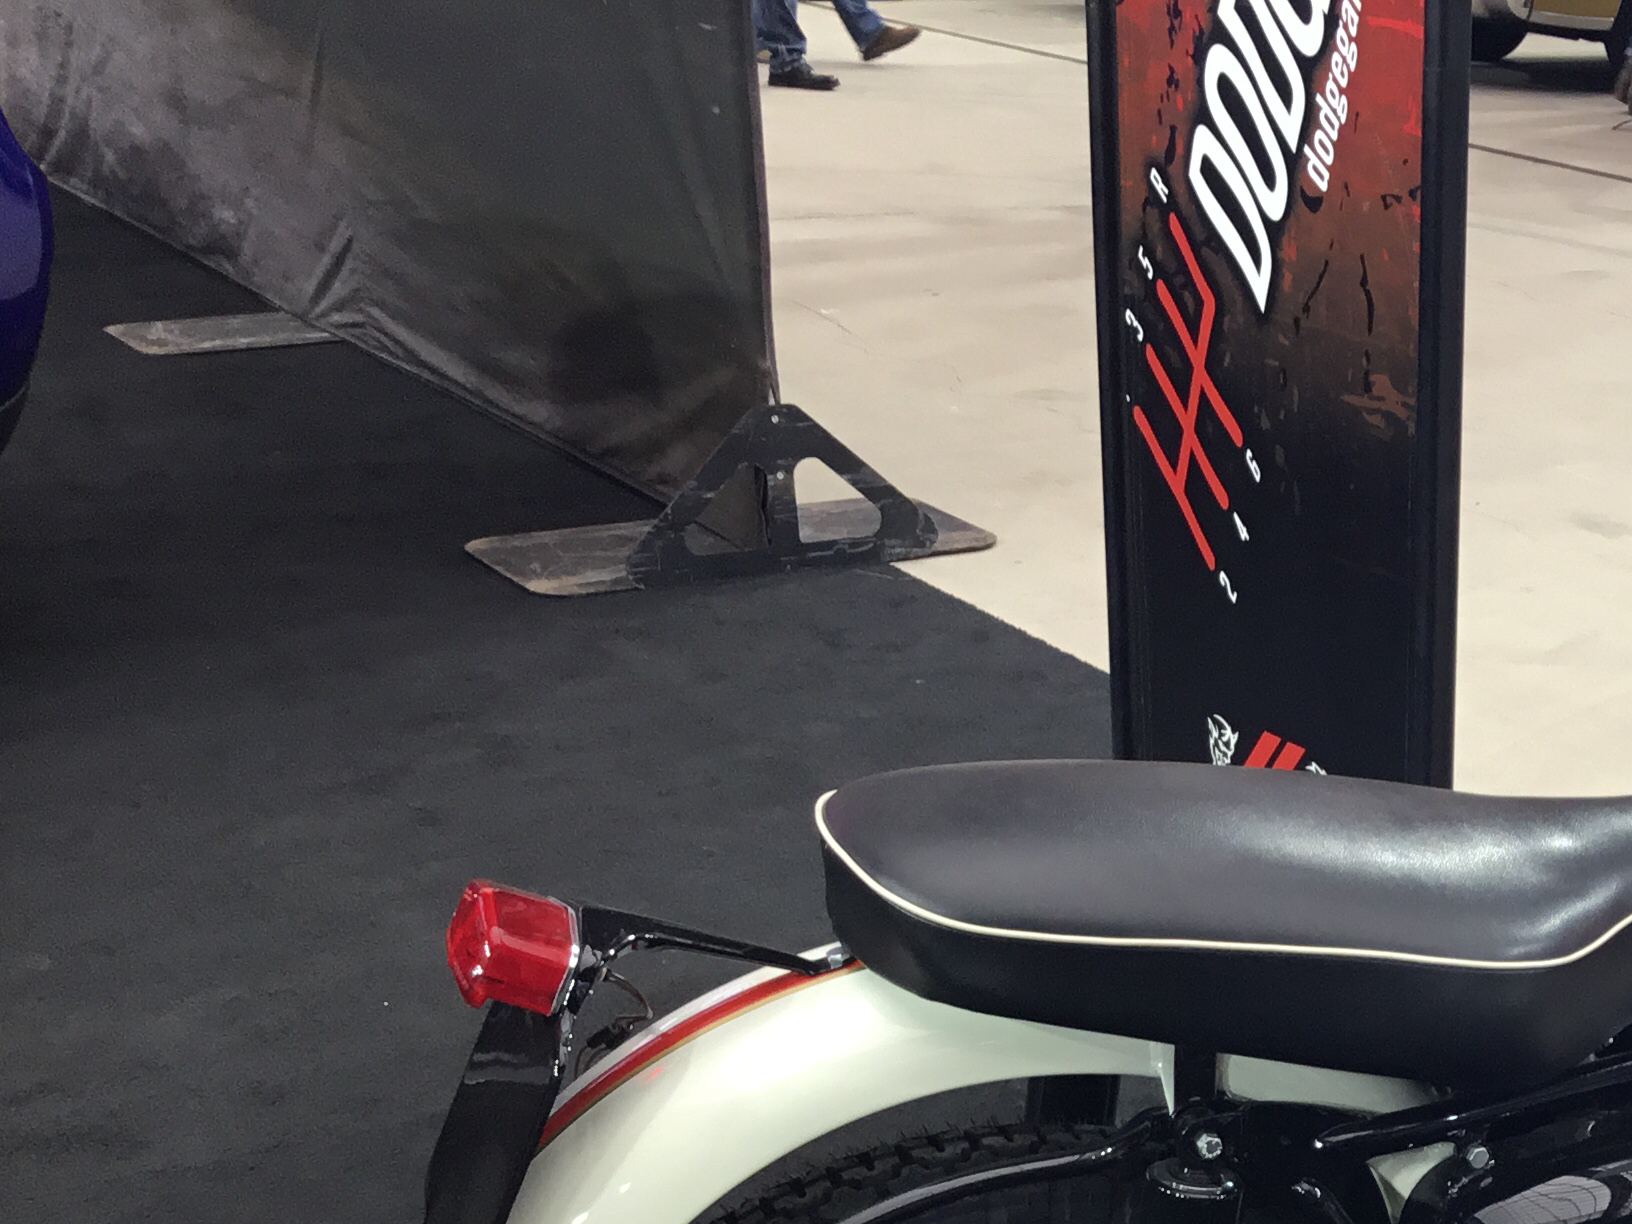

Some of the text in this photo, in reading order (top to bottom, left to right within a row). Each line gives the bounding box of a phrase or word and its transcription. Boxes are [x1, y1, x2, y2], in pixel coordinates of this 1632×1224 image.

[1125, 167, 1169, 342] 3 5 R
[1219, 448, 1262, 604] 2 4 6
